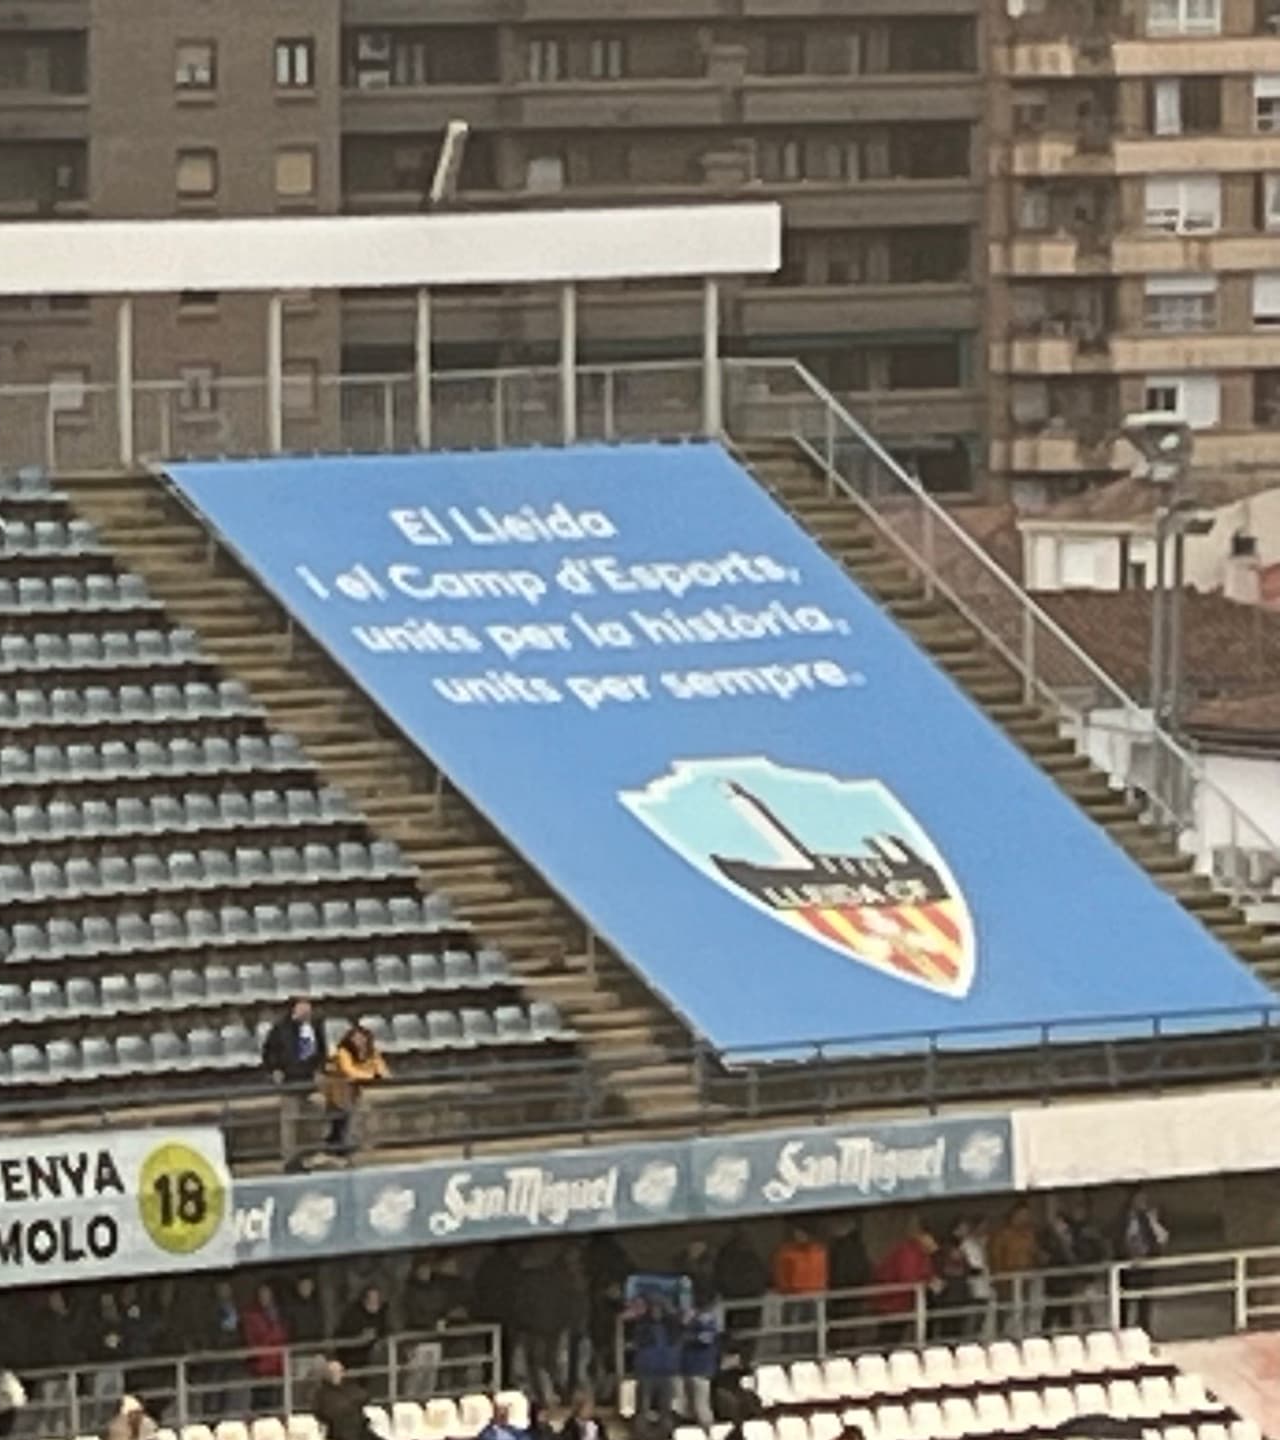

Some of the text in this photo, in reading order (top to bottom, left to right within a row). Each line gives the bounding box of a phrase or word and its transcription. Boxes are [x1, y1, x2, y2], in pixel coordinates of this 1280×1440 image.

[389, 503, 617, 545] El Lleida
[336, 563, 387, 601] el
[389, 564, 547, 605] Camp
[353, 617, 482, 653] units
[485, 621, 572, 660] per
[571, 611, 636, 648] la
[432, 670, 563, 704] units
[566, 674, 651, 708] per
[153, 1171, 207, 1226] 18
